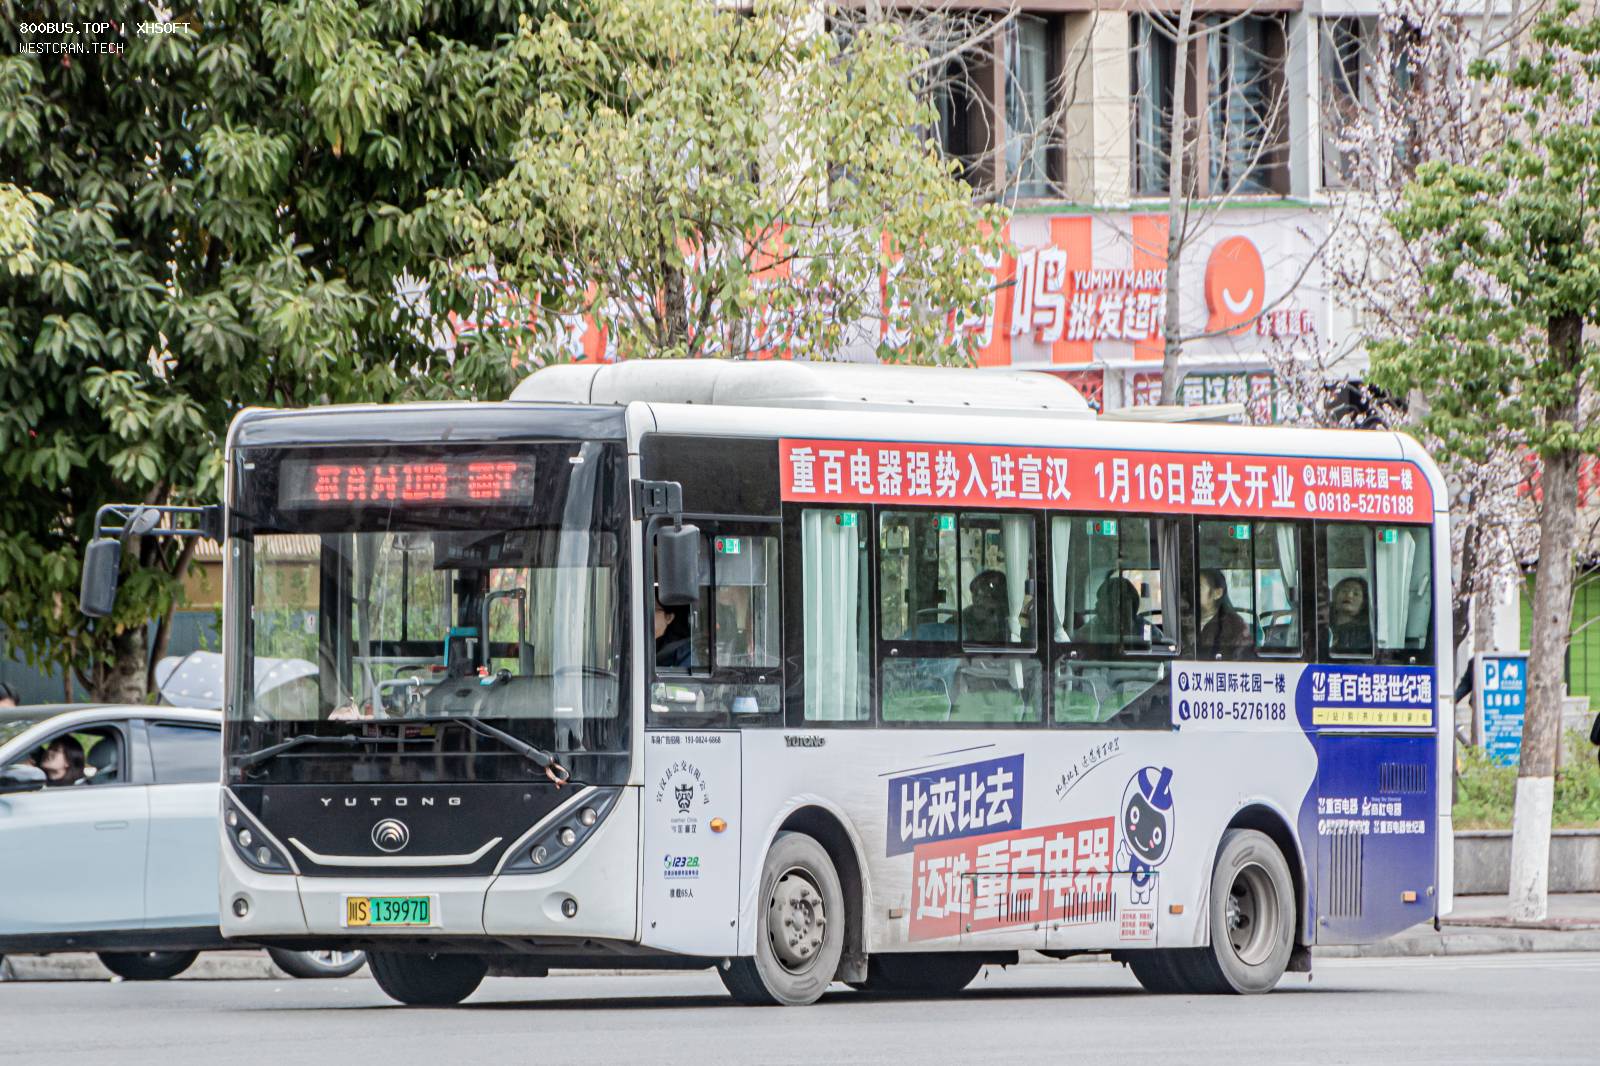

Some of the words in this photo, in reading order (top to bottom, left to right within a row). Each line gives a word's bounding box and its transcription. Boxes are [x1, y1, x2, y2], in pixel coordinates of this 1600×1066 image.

[1074, 270, 1122, 291] YUMMY
[789, 447, 1071, 501] 重百电器强势入驻宣汉
[1094, 457, 1296, 509] 1月16日盛大开业
[1316, 465, 1413, 491] 汉州国际花园一楼
[1318, 493, 1414, 515] 0818-5276188
[1191, 672, 1286, 694] 汉州国际花园一楼
[1485, 663, 1496, 686] P
[1327, 672, 1432, 704] 重百电器世纪通
[1193, 702, 1286, 721] 0818-5276188
[320, 797, 461, 807] YUTONG
[900, 766, 1014, 843] 比来比去
[672, 856, 699, 868] 12328
[915, 826, 1113, 921] 还选重百电器
[375, 900, 428, 921] 13997D
